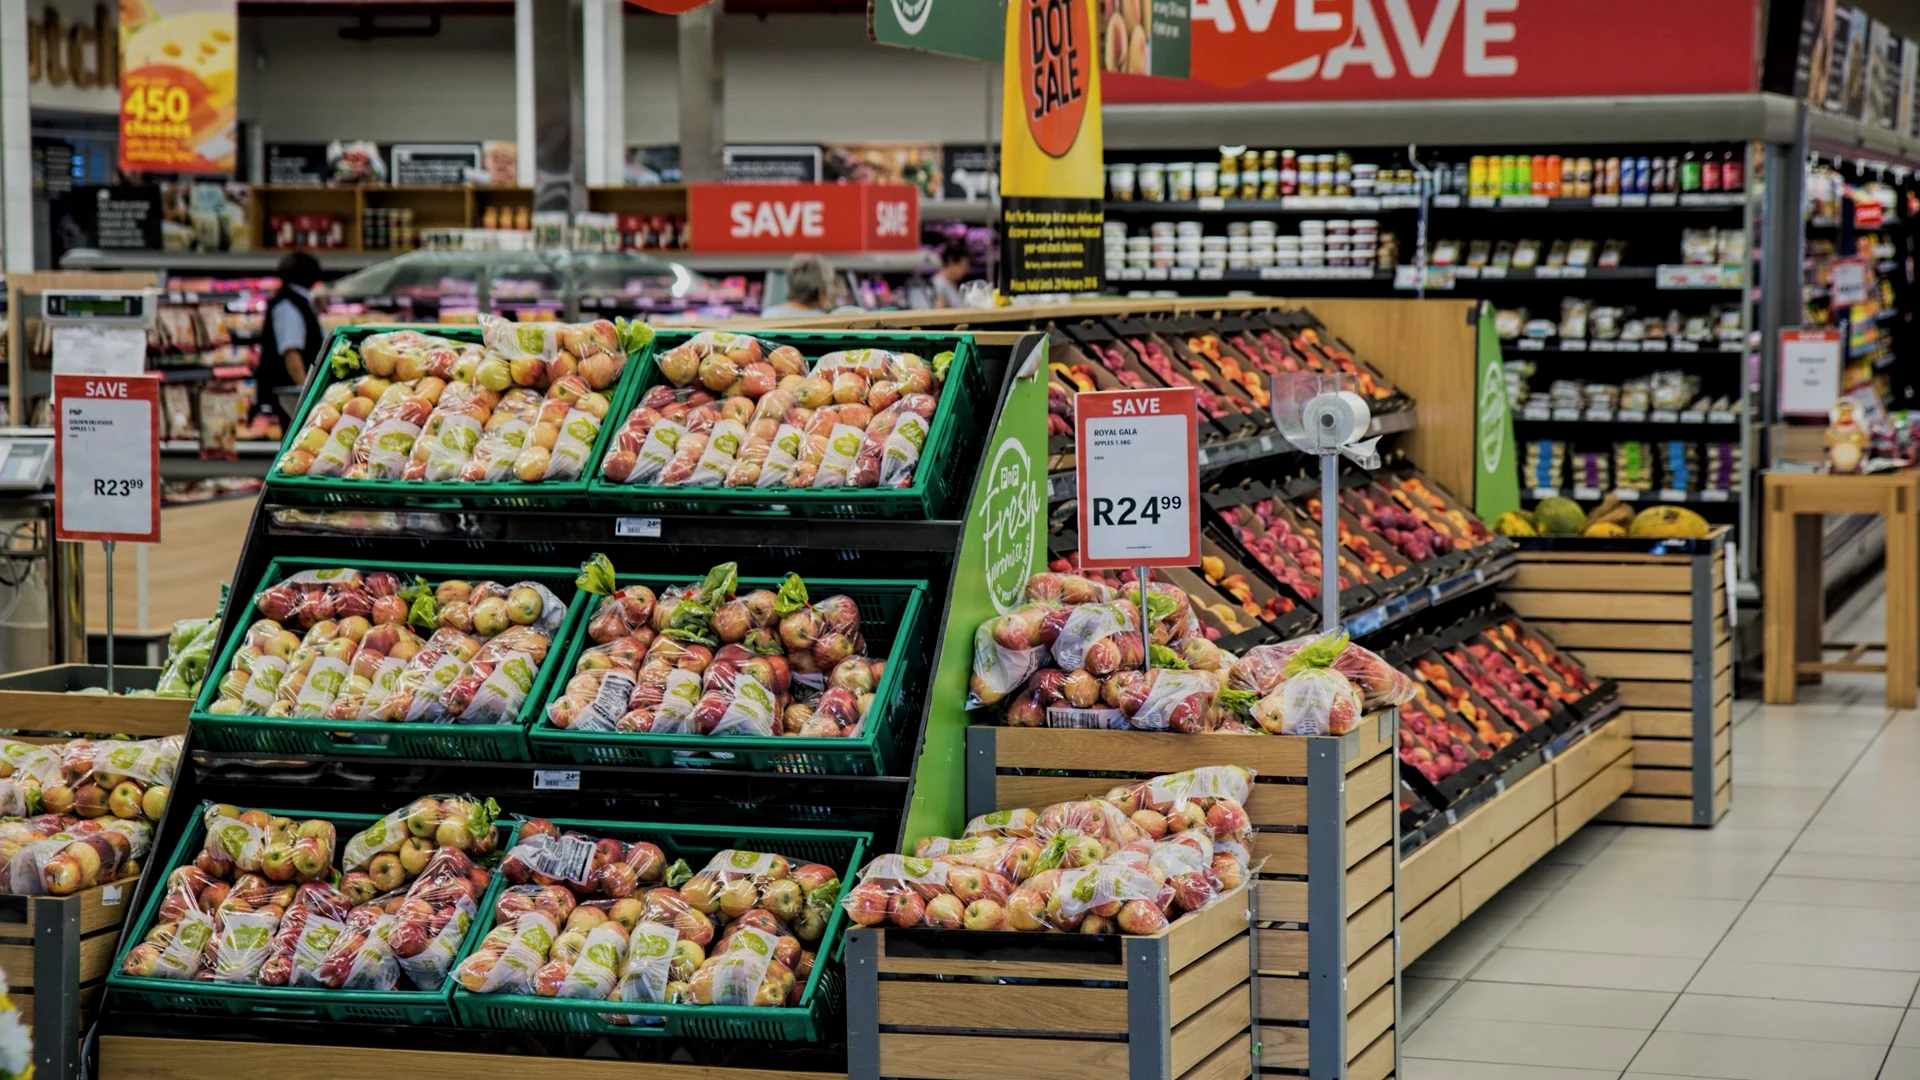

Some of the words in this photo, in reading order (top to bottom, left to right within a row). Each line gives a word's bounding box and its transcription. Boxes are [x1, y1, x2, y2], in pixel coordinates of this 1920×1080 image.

[1031, 0, 1072, 66] DOT
[1033, 48, 1082, 119] SALE
[124, 85, 190, 124] 450
[730, 200, 825, 238] SAVE
[875, 200, 909, 237] SAVE
[85, 381, 128, 398] SAVE
[1112, 397, 1160, 415] SAVE
[1094, 429, 1117, 437] ROYAL
[1119, 428, 1138, 436] GALA
[979, 456, 1041, 553] Fresh
